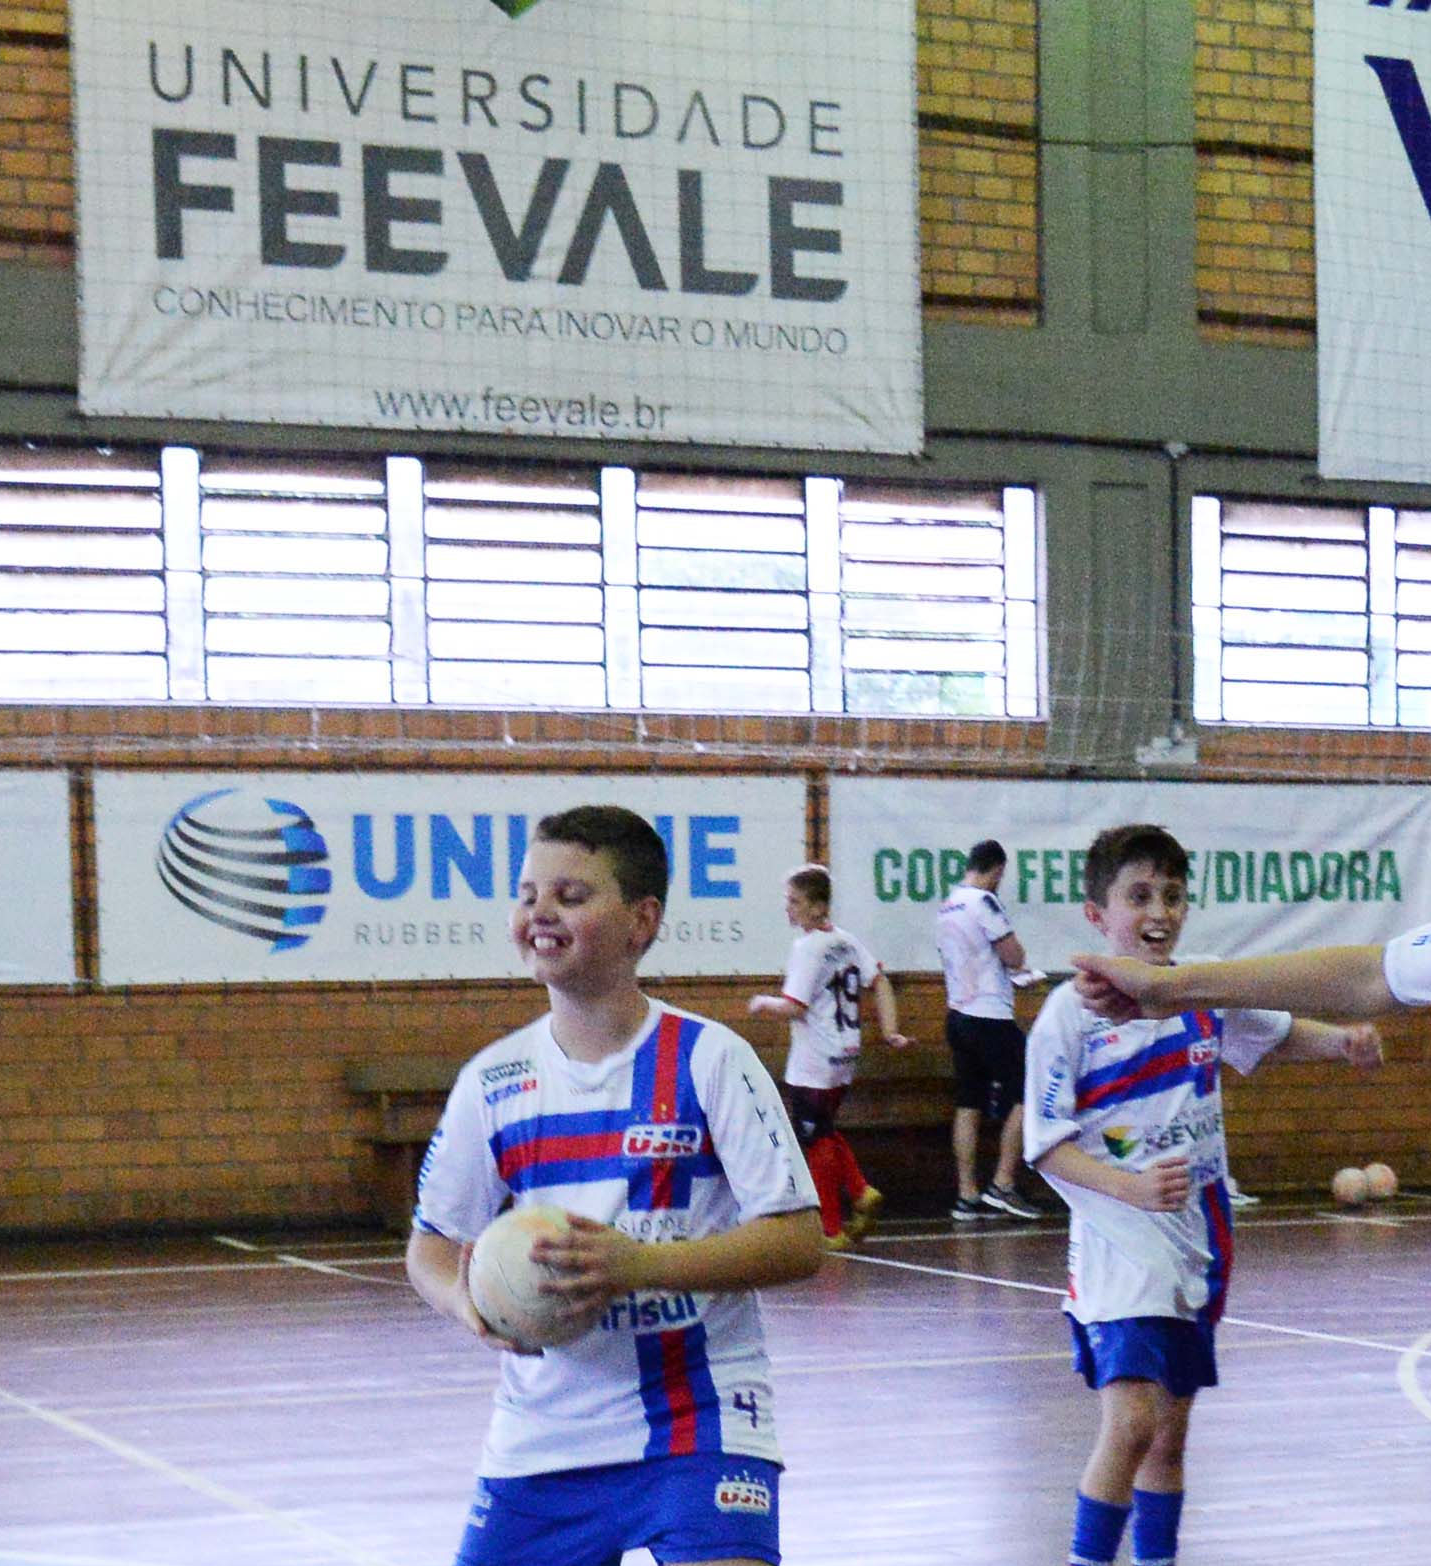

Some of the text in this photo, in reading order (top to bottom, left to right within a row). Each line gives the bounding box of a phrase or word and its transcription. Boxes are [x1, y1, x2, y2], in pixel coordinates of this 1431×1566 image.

[148, 41, 844, 157] UNIVERSIDADE
[153, 126, 849, 304] FEEVALE
[154, 284, 849, 356] CONHECIMENTO PARA INOVAR O MUNDO
[373, 385, 672, 432] www.feevale.br
[352, 813, 742, 900] UNIE
[873, 848, 1403, 908] COP FEEE/DIADORA
[354, 922, 486, 945] RUBBER
[601, 1289, 698, 1331] risul
[732, 1389, 759, 1428] 4
